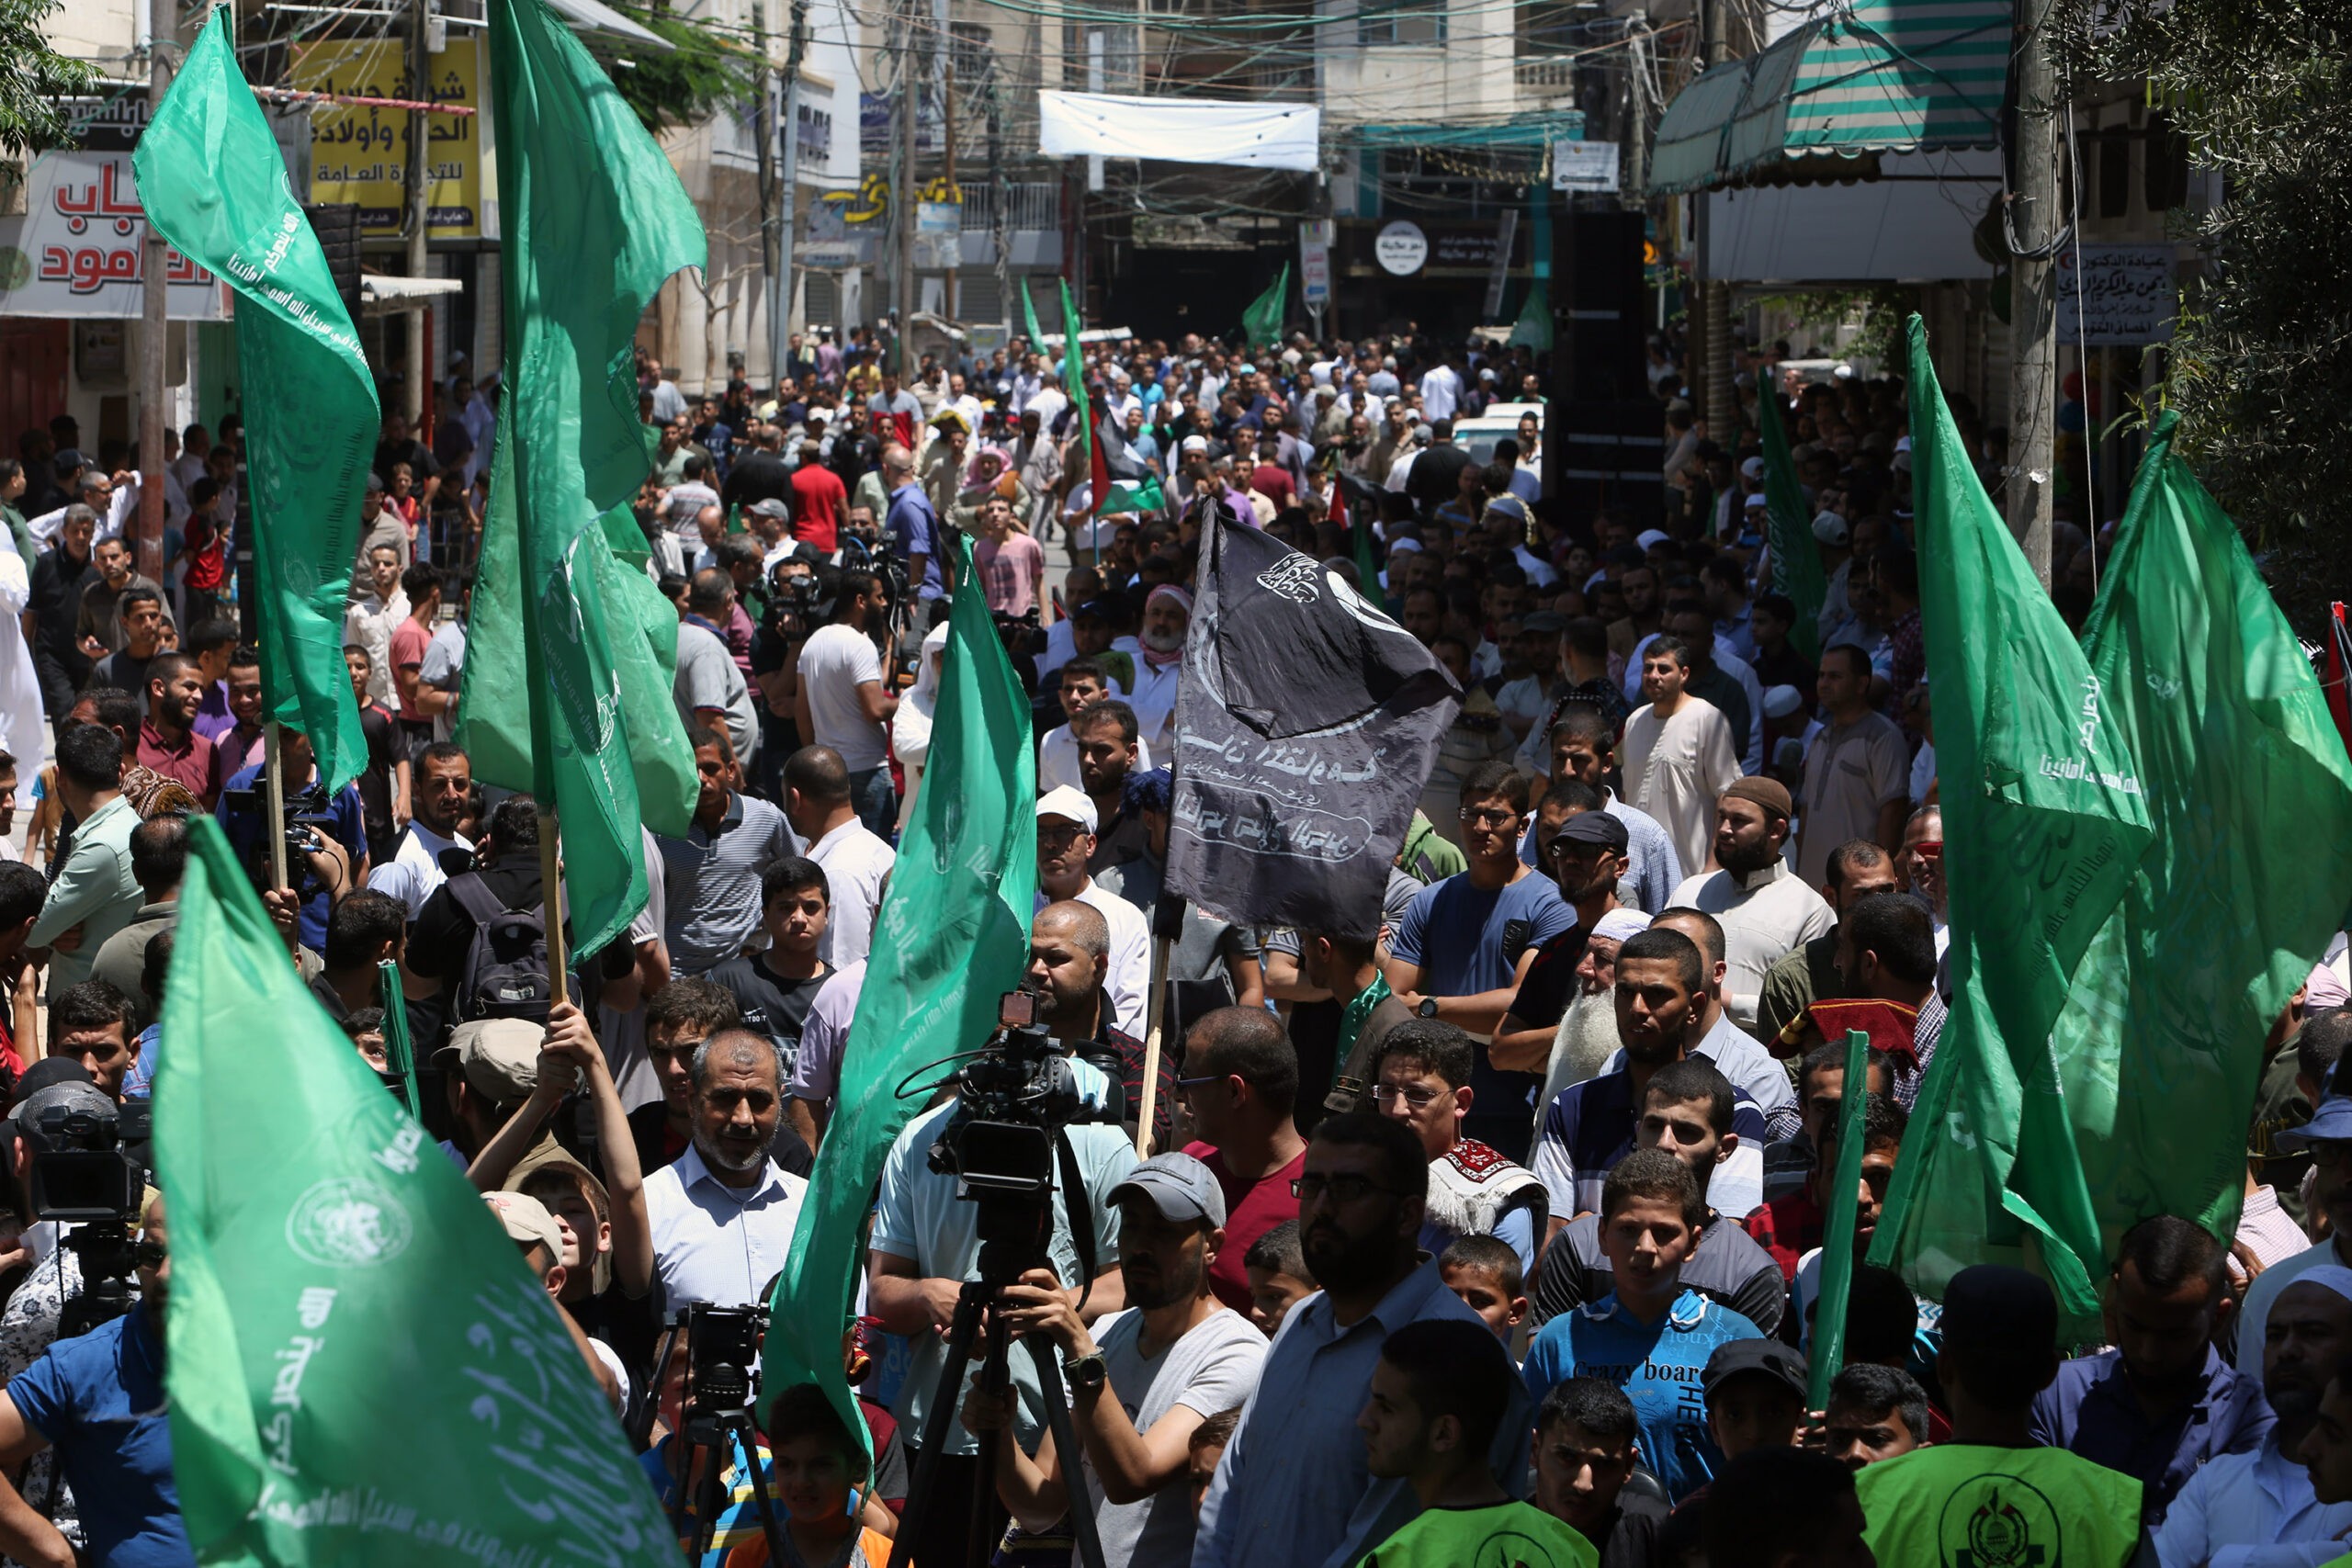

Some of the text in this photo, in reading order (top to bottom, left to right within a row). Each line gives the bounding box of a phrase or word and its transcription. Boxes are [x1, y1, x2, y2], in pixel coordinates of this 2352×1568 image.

[393, 71, 466, 102] شرة
[317, 162, 462, 186] للتجة العامة
[1573, 1359, 1638, 1386] Crazy
